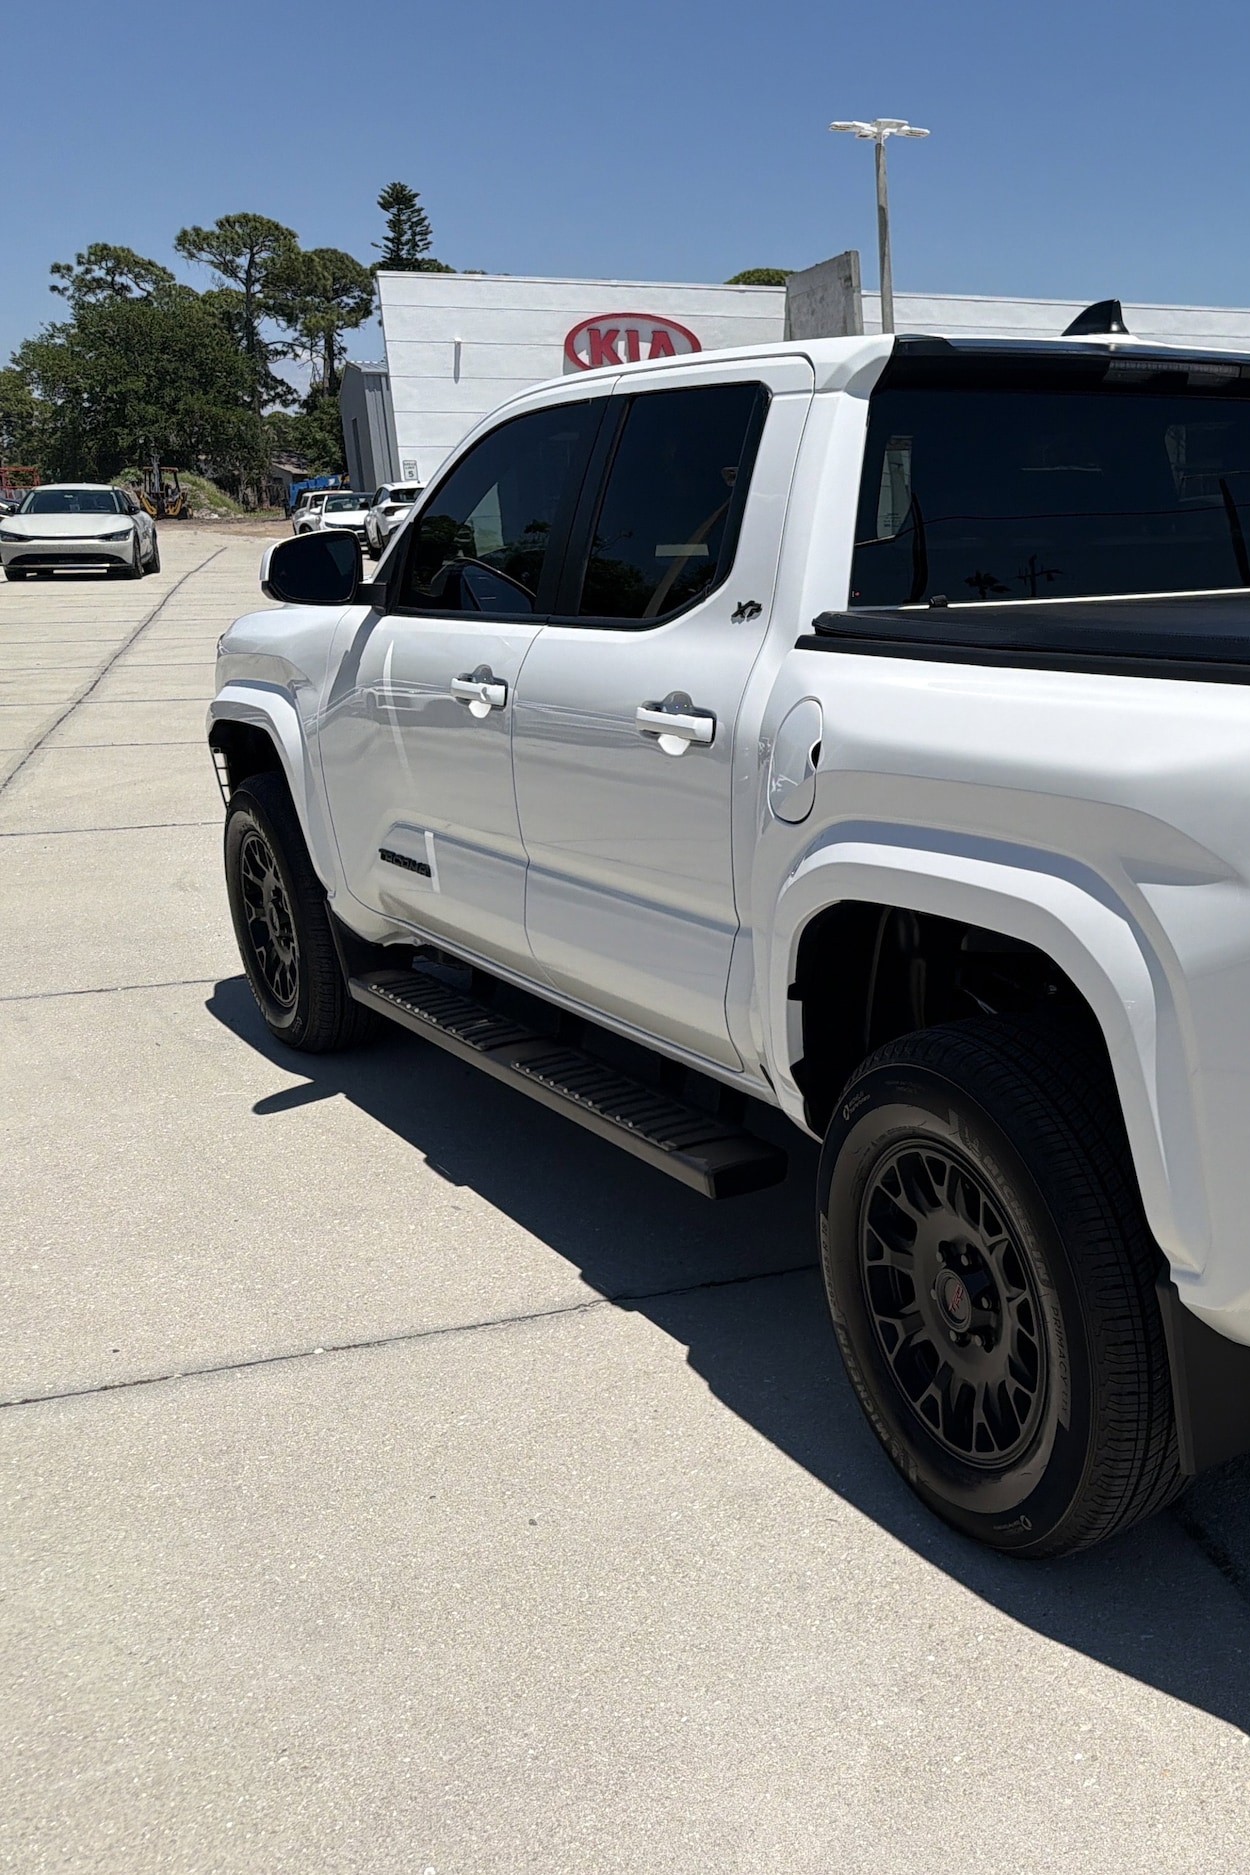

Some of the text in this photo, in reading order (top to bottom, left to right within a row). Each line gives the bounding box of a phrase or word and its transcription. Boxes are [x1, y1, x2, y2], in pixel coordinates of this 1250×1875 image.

[587, 328, 677, 366] KIA
[408, 470, 415, 478] 5
[836, 1327, 889, 1441] MICHELIN
